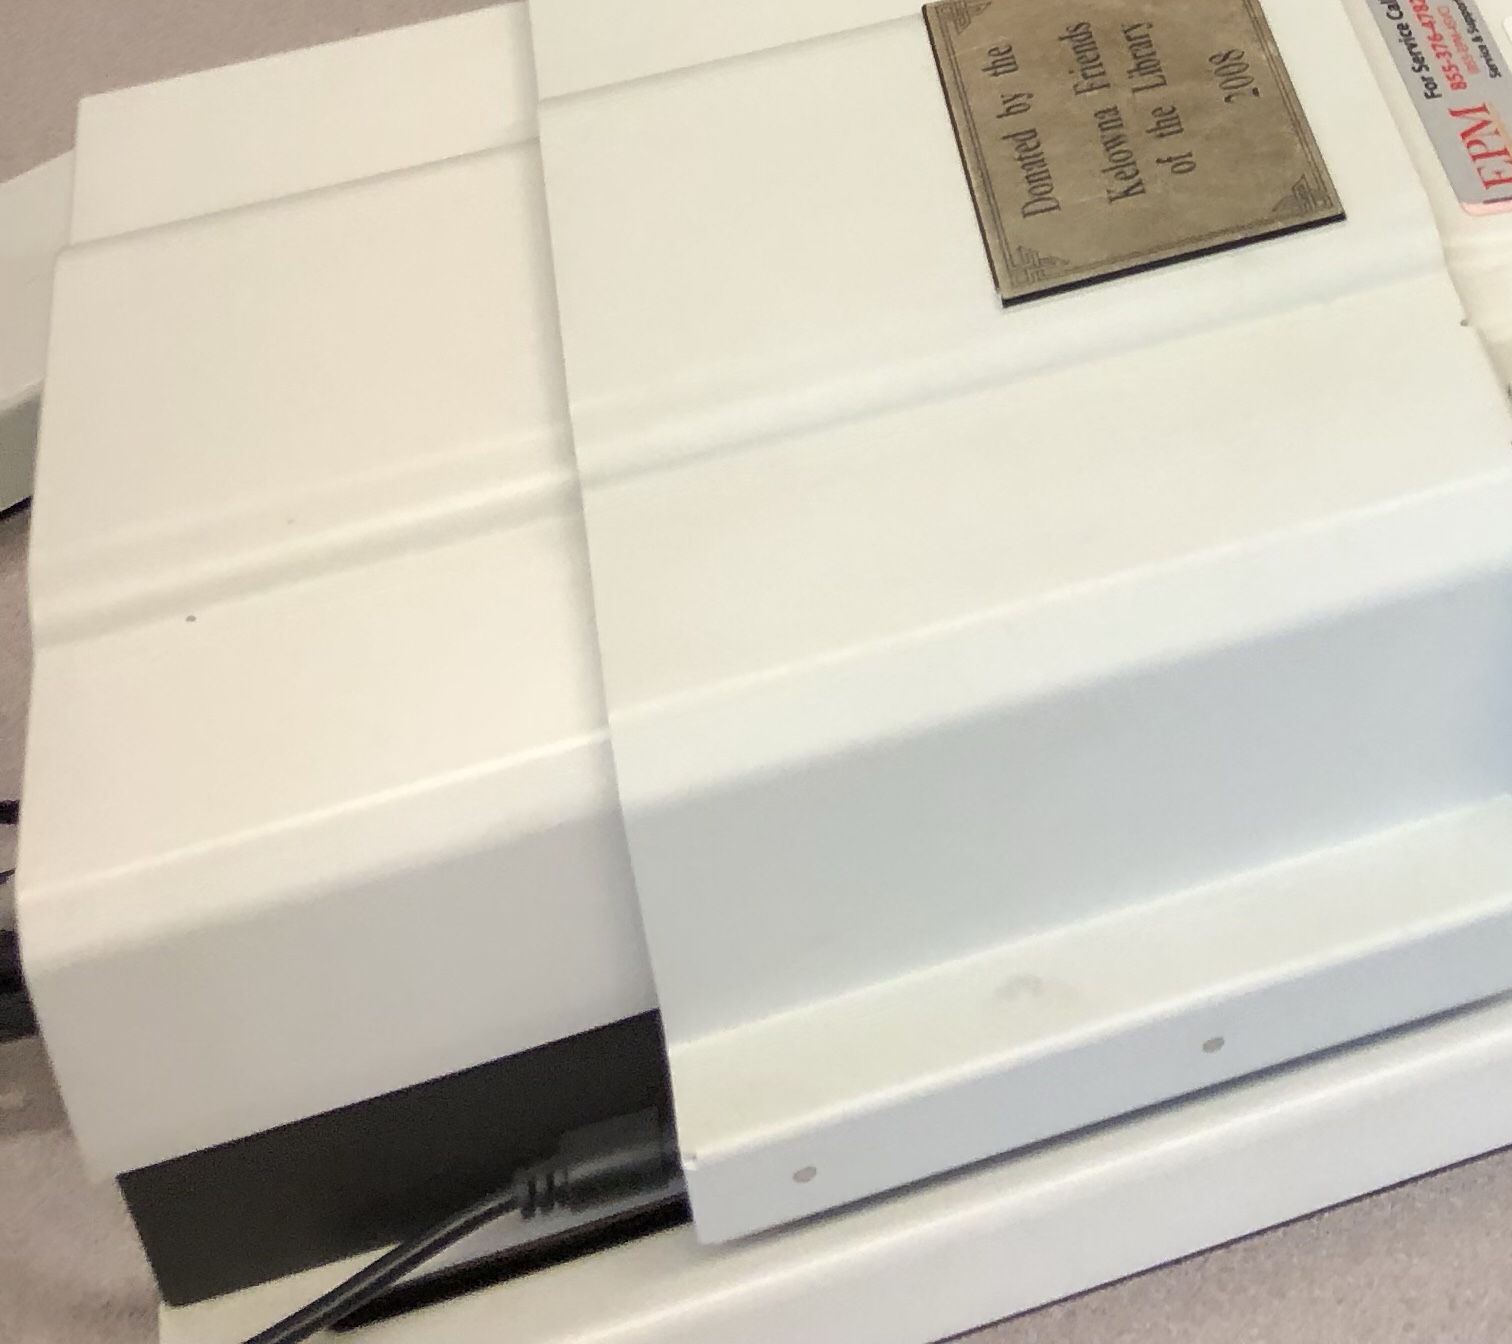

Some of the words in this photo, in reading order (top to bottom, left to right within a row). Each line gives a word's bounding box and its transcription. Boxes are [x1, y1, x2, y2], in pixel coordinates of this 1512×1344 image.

[981, 43, 1019, 78] the
[1057, 20, 1111, 96] Friends
[1120, 21, 1168, 94] Library
[1397, 23, 1430, 72] Service
[1207, 48, 1261, 104] 2008
[1421, 75, 1442, 99] For
[996, 92, 1034, 120] by
[1145, 104, 1185, 141] the
[1001, 127, 1062, 219] Donated
[1093, 104, 1147, 204] Kelowna
[1156, 150, 1197, 175] of
